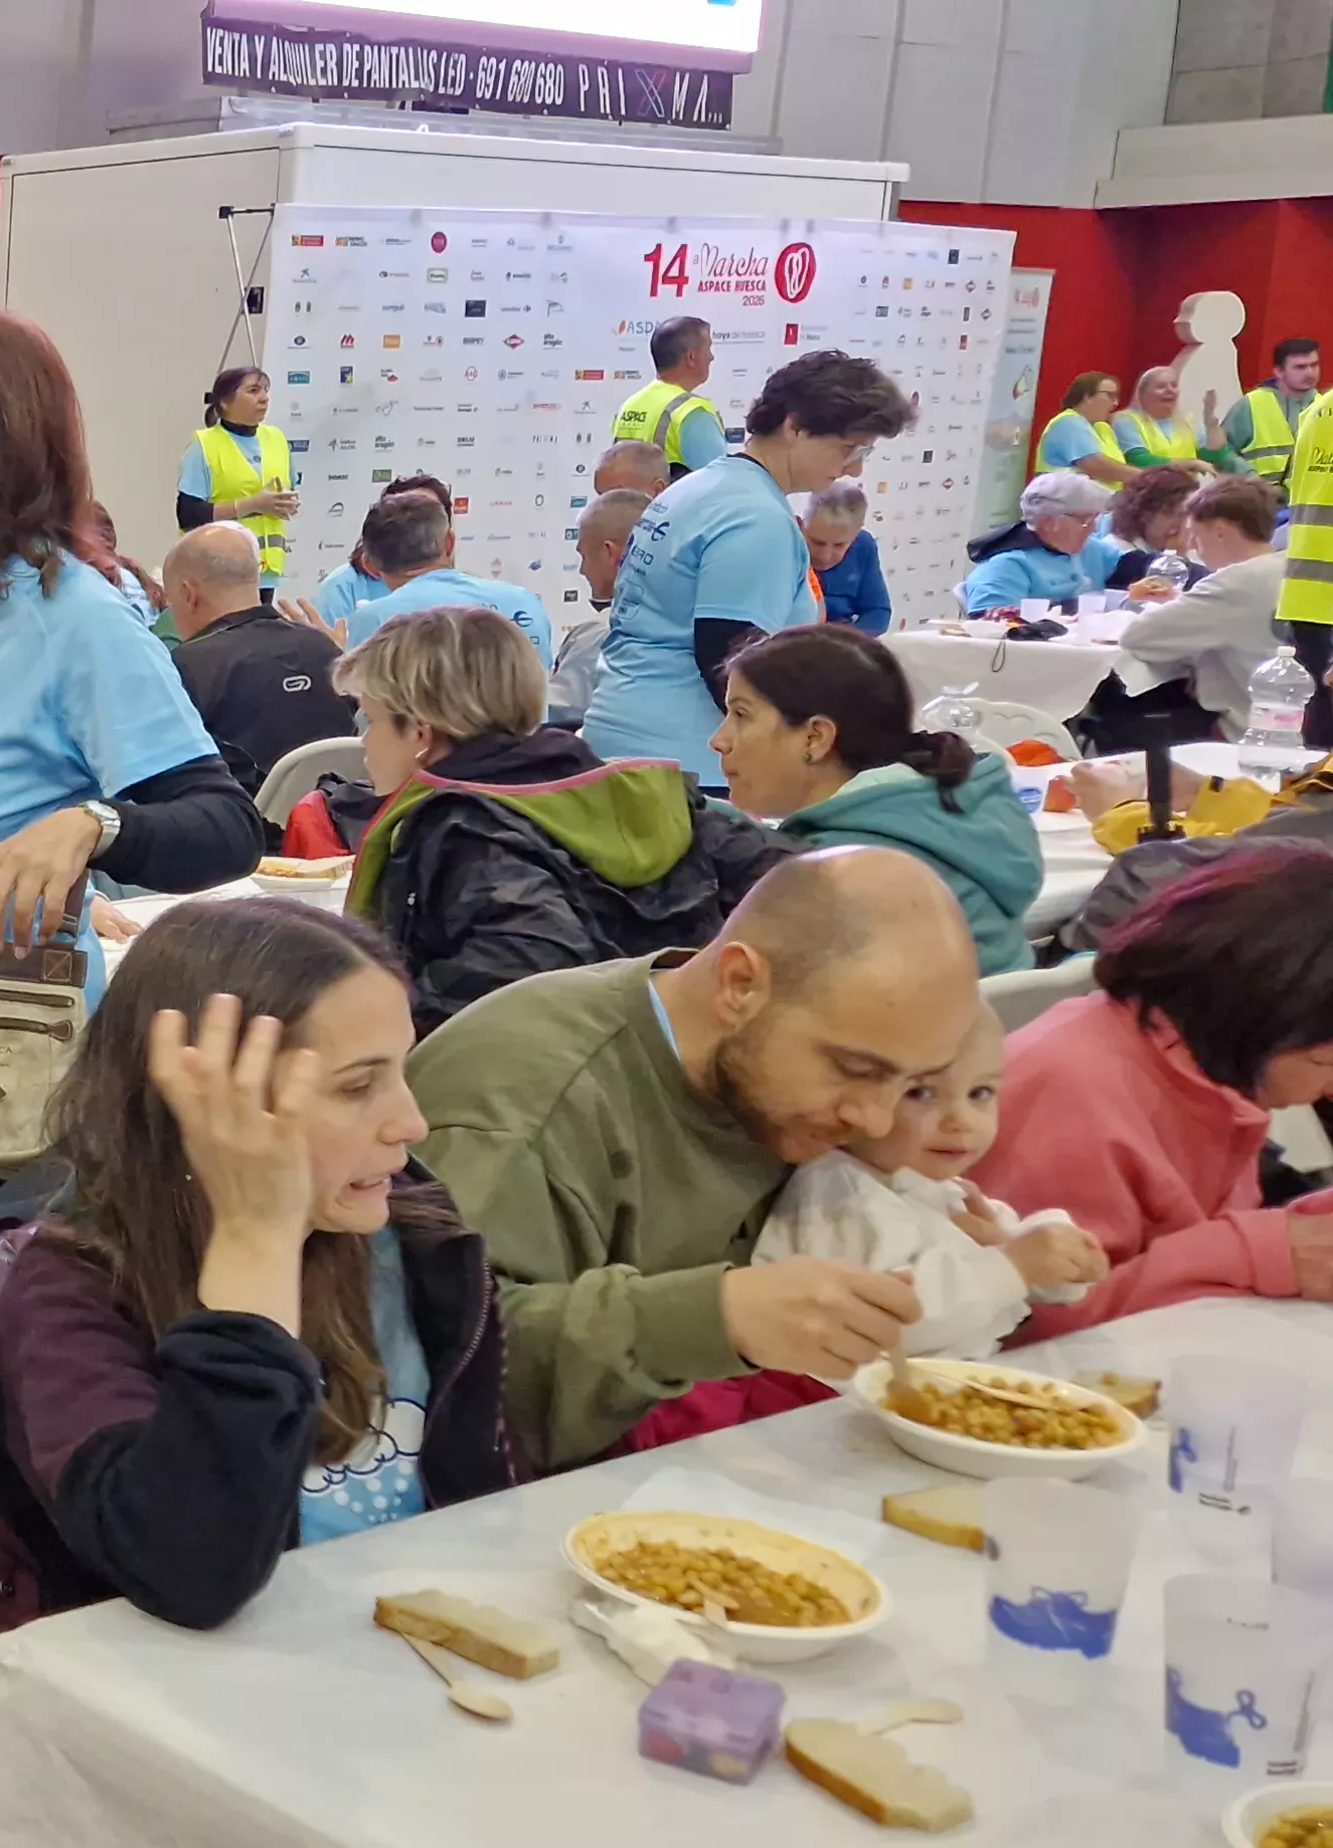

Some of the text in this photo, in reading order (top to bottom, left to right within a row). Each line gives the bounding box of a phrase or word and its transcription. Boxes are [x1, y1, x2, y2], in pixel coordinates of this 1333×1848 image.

[207, 27, 250, 78] VENTA
[254, 35, 265, 79] Y
[268, 36, 338, 86] ALQUILER
[342, 43, 360, 87] DE
[438, 51, 466, 95] LED
[476, 56, 507, 99] 691
[507, 59, 535, 103] 680
[535, 62, 564, 105] 680
[700, 243, 769, 277] Marcha
[697, 280, 766, 293] ASPACE HUESCA
